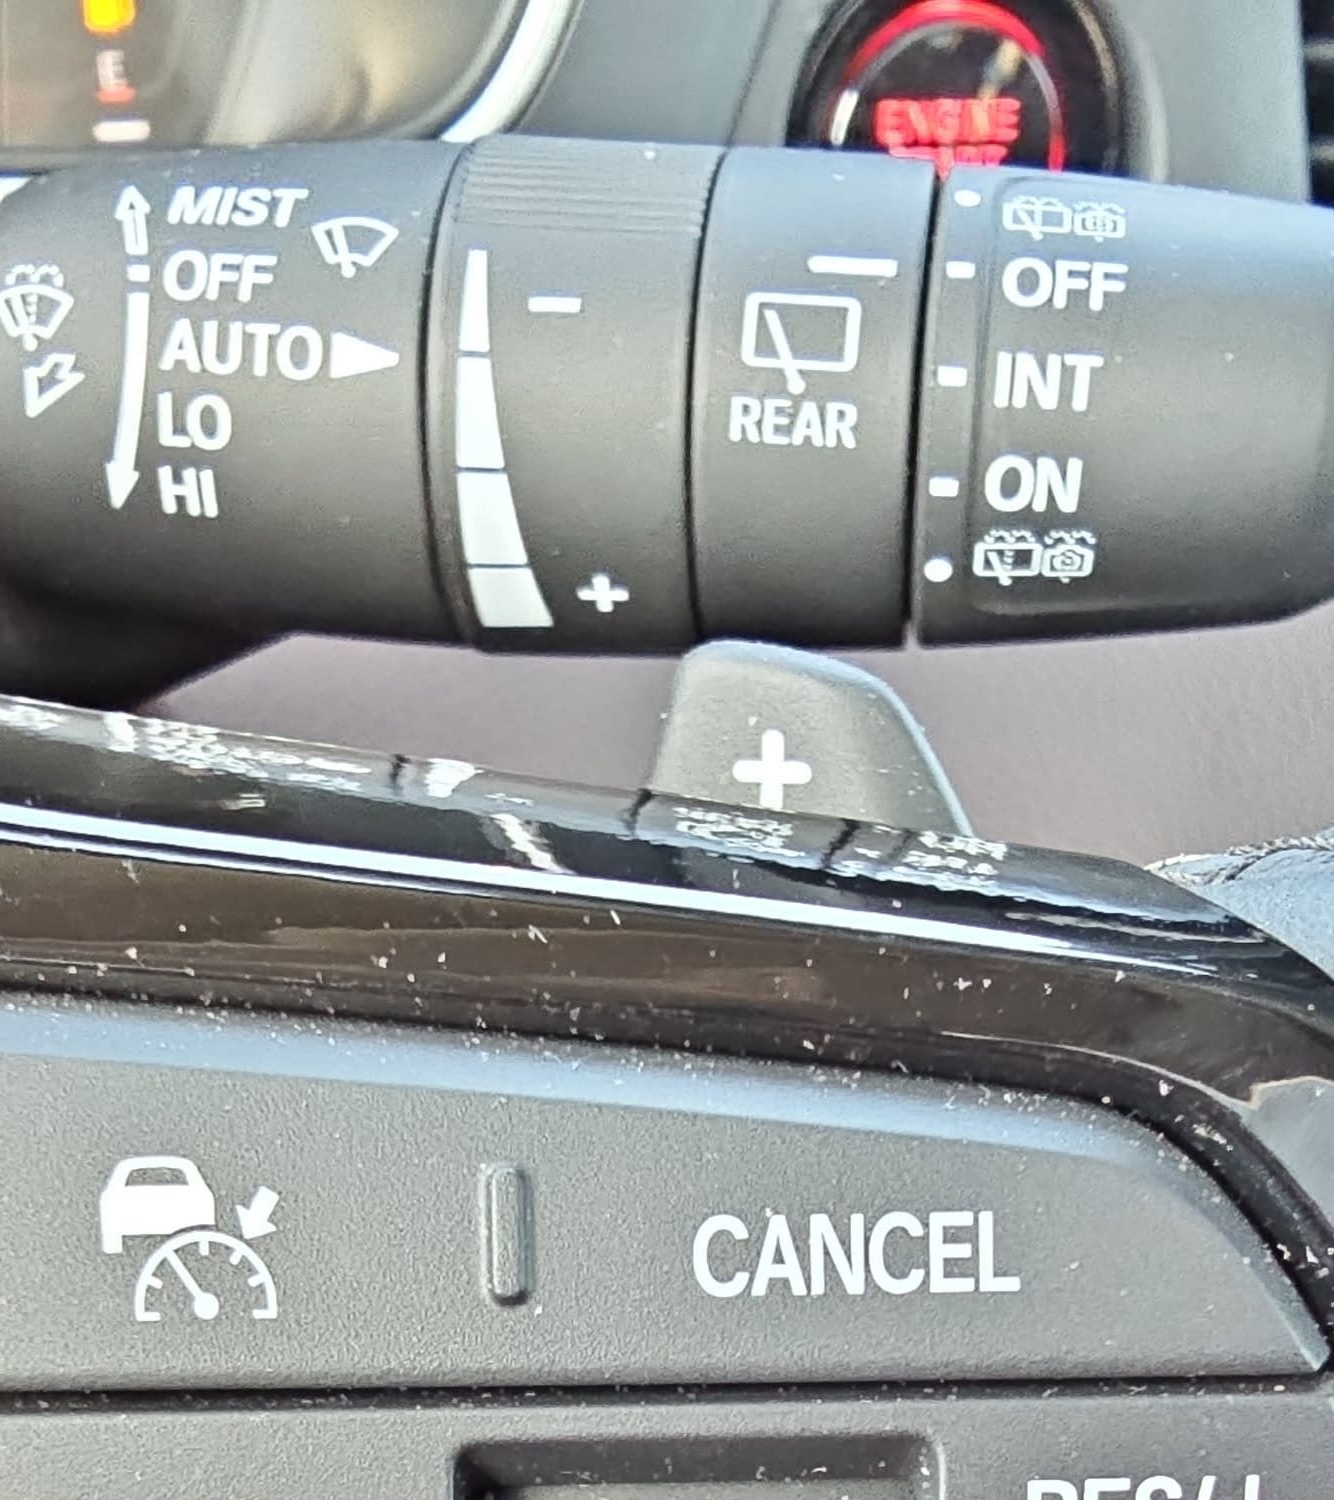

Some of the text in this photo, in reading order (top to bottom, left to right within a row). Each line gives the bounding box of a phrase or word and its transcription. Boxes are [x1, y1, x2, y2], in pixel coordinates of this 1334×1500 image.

[167, 186, 309, 228] MIST
[164, 250, 277, 302] OFF
[1001, 257, 1128, 311] OFF
[158, 320, 323, 380] AUTO
[992, 351, 1104, 412] INT
[157, 392, 232, 450] LO
[727, 395, 858, 449] REAR
[157, 464, 220, 518] HI
[983, 456, 1083, 513] ON
[691, 1210, 1021, 1298] CANCEL
